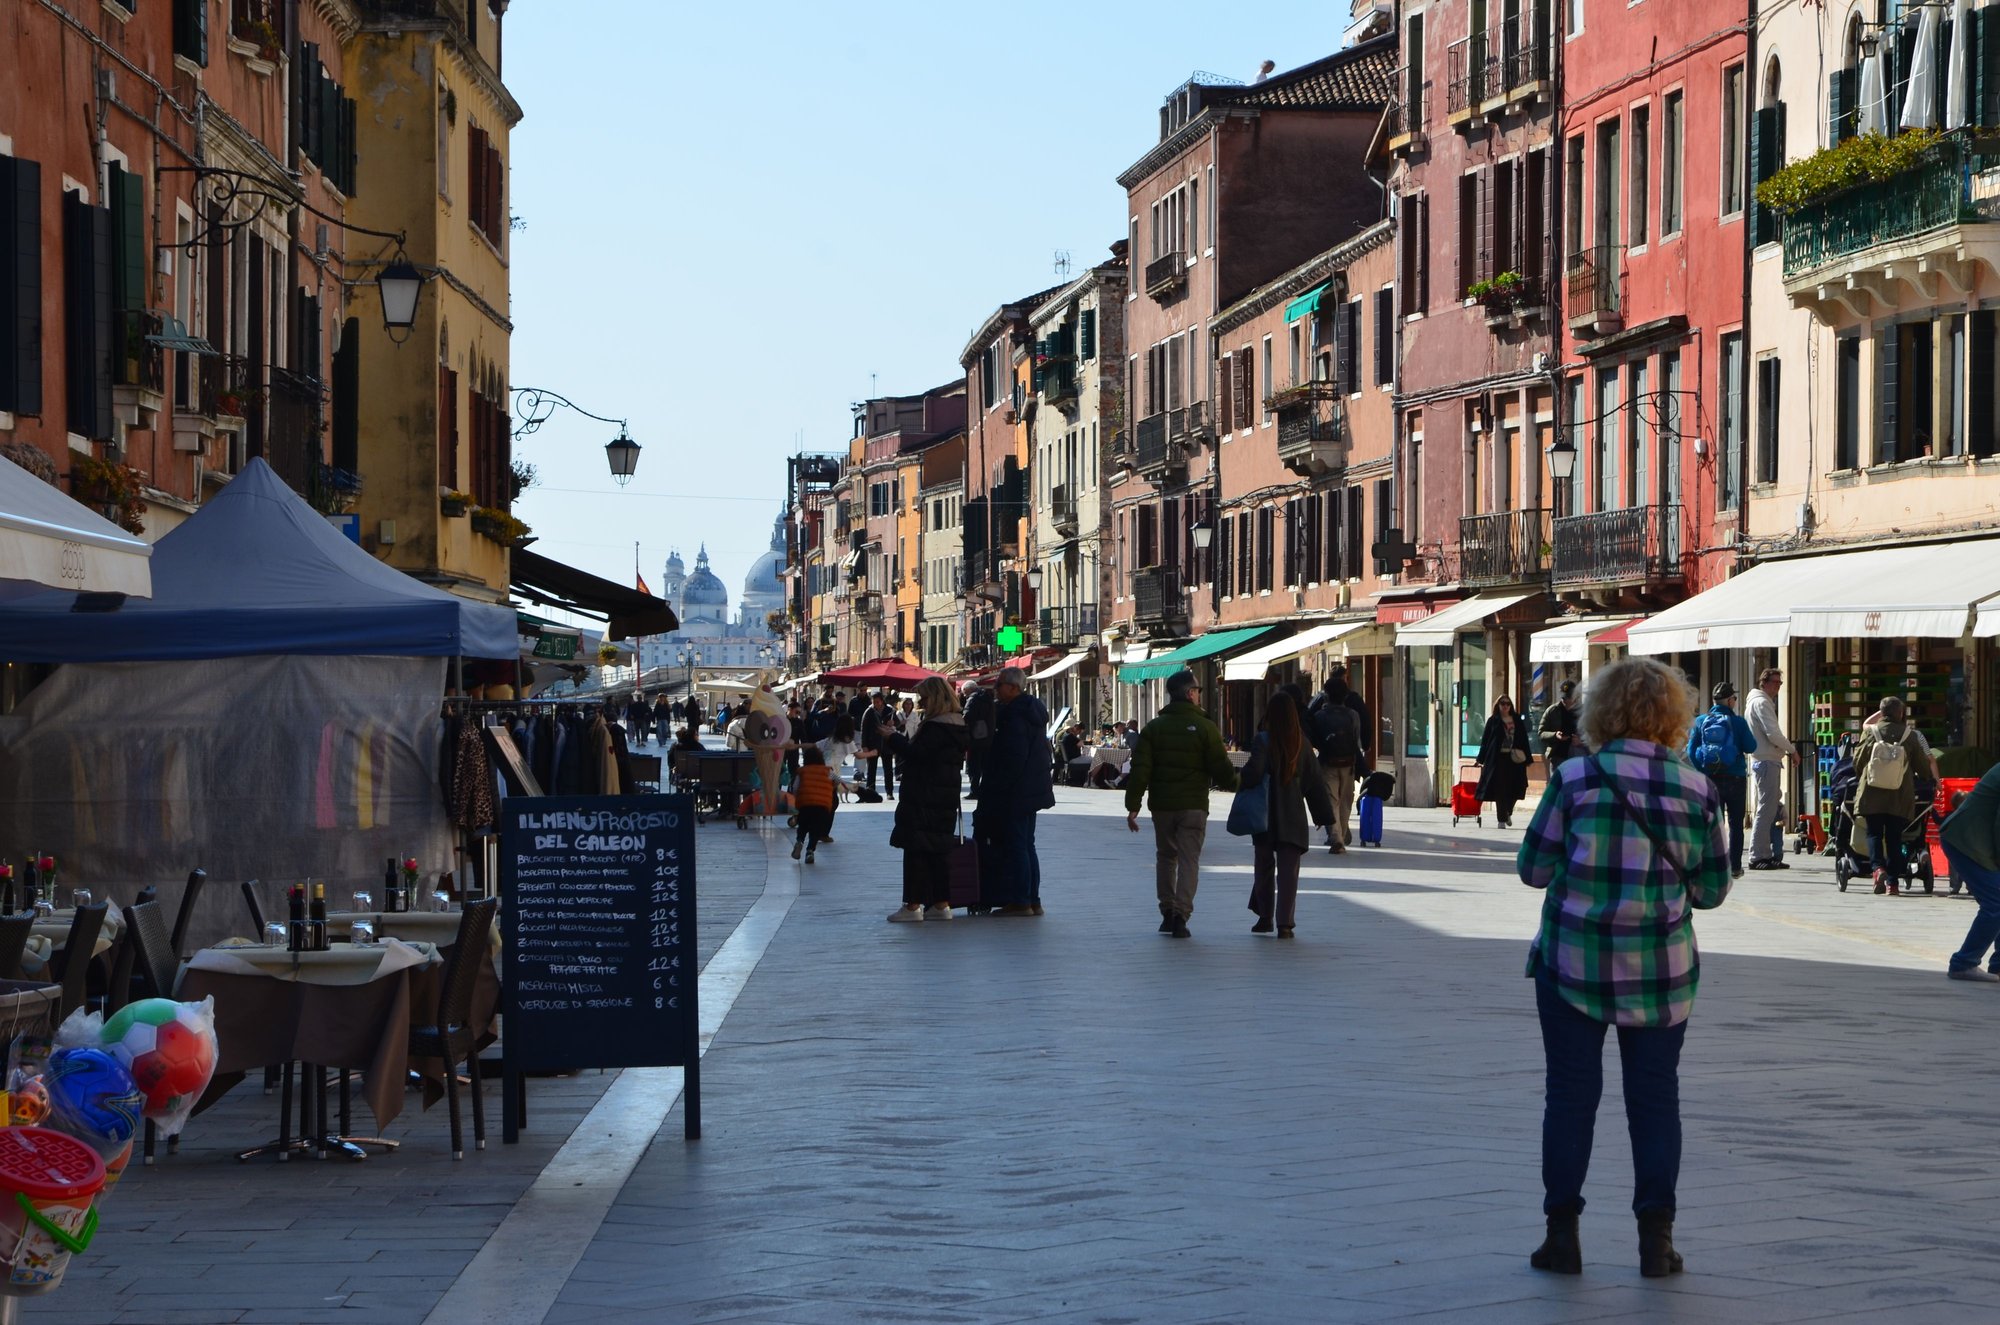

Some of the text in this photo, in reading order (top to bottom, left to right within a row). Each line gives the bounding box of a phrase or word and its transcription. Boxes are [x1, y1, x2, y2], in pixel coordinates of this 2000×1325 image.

[519, 813, 541, 829] IL
[597, 811, 678, 832] PROPOSTO
[534, 834, 646, 852] DEL GALEON
[655, 866, 680, 877] 10€
[517, 882, 556, 891] SPAGHETTI
[517, 895, 555, 904] LASAGNA
[575, 896, 614, 904] VERDURE
[577, 955, 602, 964] POLLO
[567, 982, 603, 994] MISTA
[518, 999, 569, 1010] VERDURE
[571, 1000, 582, 1009] DI
